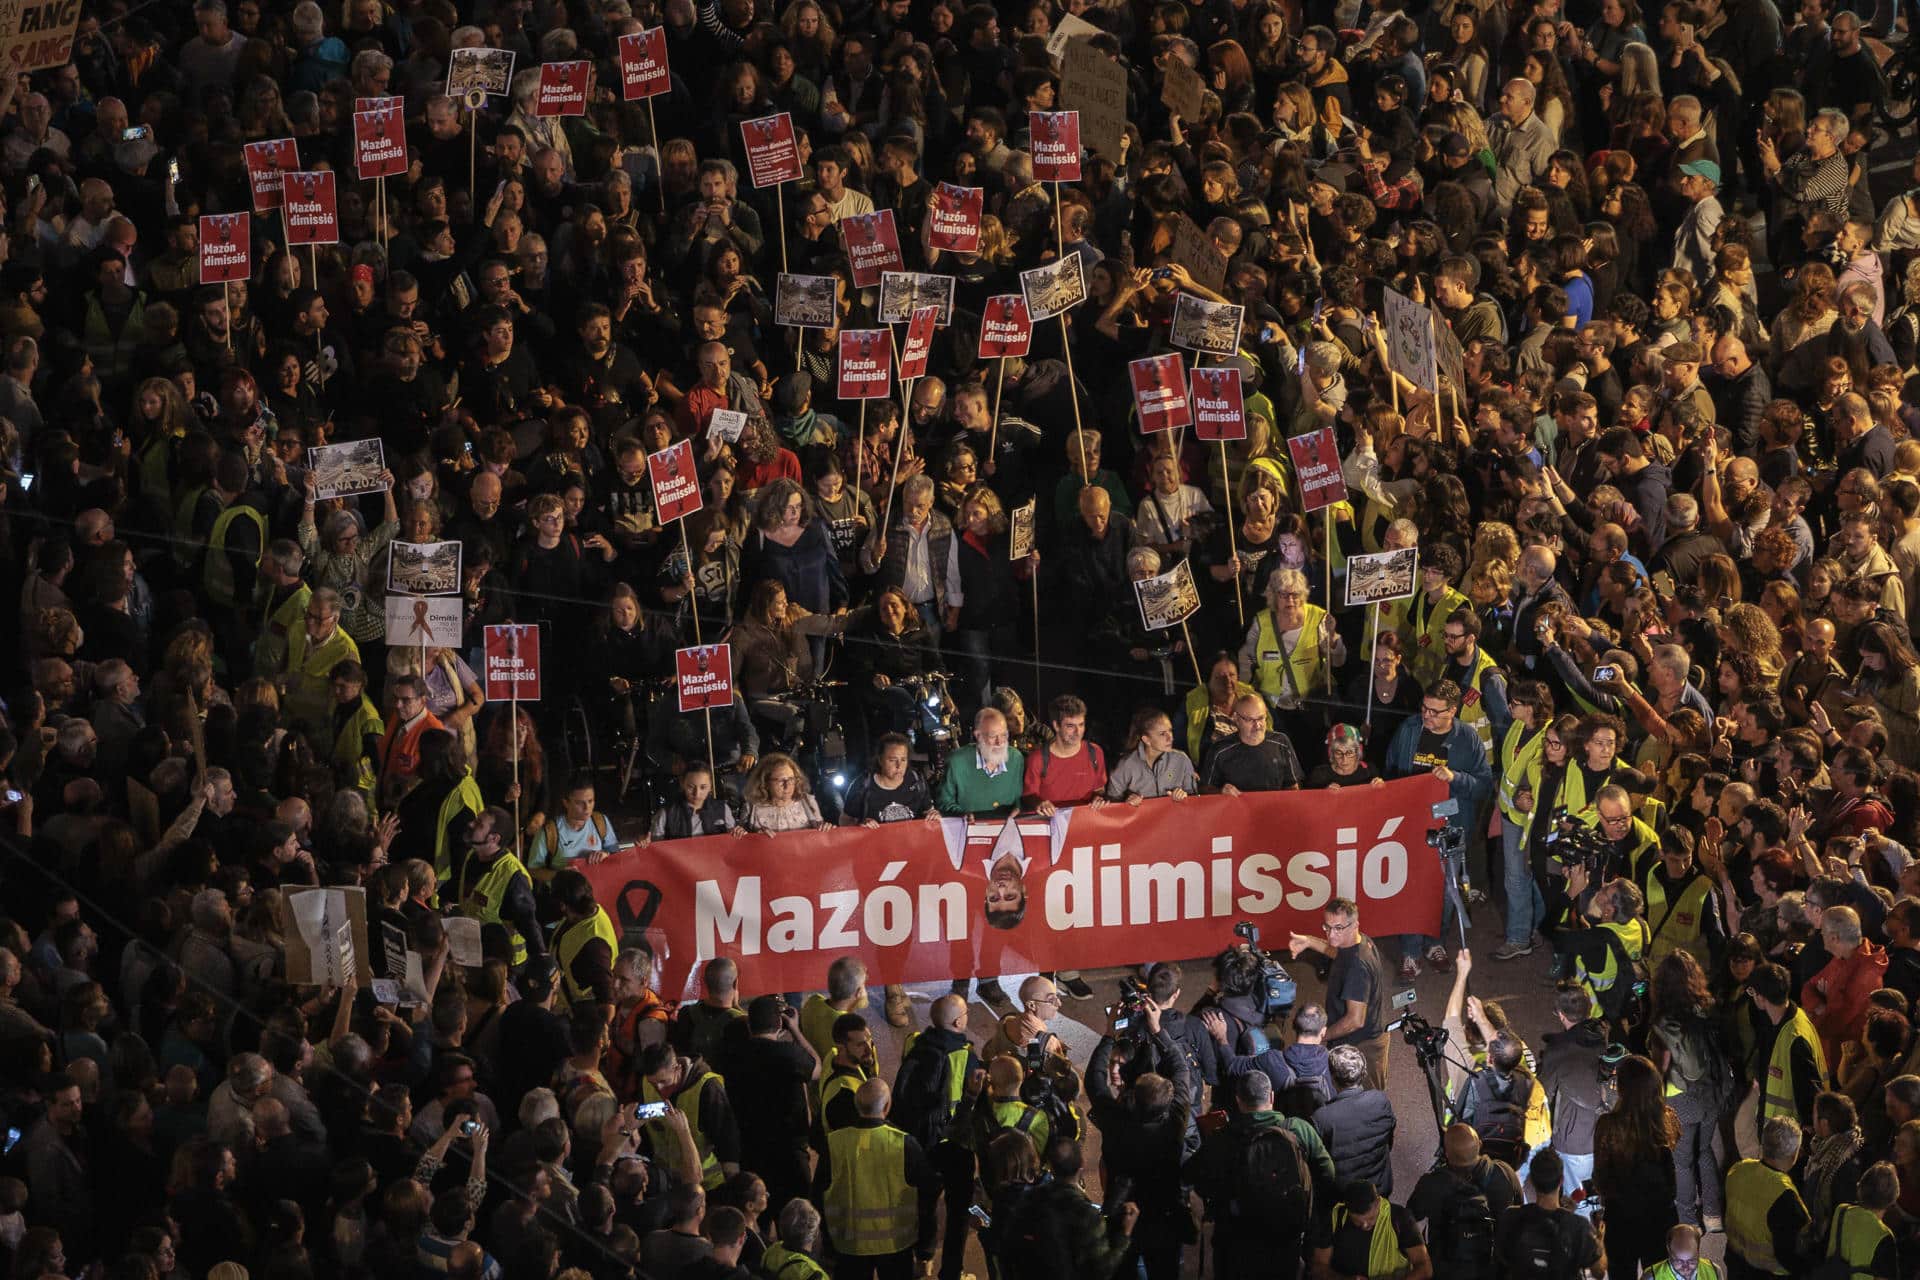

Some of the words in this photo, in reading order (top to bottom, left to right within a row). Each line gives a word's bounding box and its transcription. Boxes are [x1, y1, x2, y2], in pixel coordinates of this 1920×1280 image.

[19, 0, 76, 33] FANG
[10, 34, 73, 65] SANG
[625, 57, 656, 73] Mazón
[626, 66, 666, 85] dimissió
[542, 84, 573, 95] Mazón
[541, 93, 583, 104] dimissió
[360, 137, 392, 151] Mazón
[1034, 140, 1065, 153] Mazón
[362, 146, 404, 162] dimissió
[1035, 151, 1077, 165] dimissió
[289, 200, 322, 214] Mazón
[290, 212, 334, 226] dimissió
[936, 209, 967, 223] Mazón
[934, 222, 976, 236] dimissió
[204, 241, 237, 255] Mazón
[851, 241, 885, 257] Mazón
[204, 253, 246, 267] dimissió
[854, 253, 898, 270] dimissió
[1032, 295, 1062, 312] DANA
[884, 308, 910, 319] DAN
[986, 318, 1018, 333] Mazón
[984, 330, 1027, 343] dimissió
[1207, 336, 1233, 350] 2024
[843, 356, 876, 370] Mazón
[843, 367, 886, 382] dimissió
[1197, 397, 1228, 410] Mazón
[1198, 407, 1240, 423] dimissió
[1300, 463, 1328, 480] Mazón
[657, 474, 687, 494] Mazón
[1303, 471, 1340, 492] dimissió
[660, 481, 696, 506] dimissió
[430, 577, 456, 590] 2024
[1352, 587, 1384, 599] DANA
[1386, 583, 1410, 596] 2024
[1148, 605, 1184, 622] DANA
[490, 655, 524, 668] Mazón
[490, 666, 536, 681] dimissió
[683, 670, 716, 686] Mazón
[684, 680, 728, 696] dimissió
[696, 861, 967, 960] Mazón
[1045, 816, 1408, 930] dimissió
